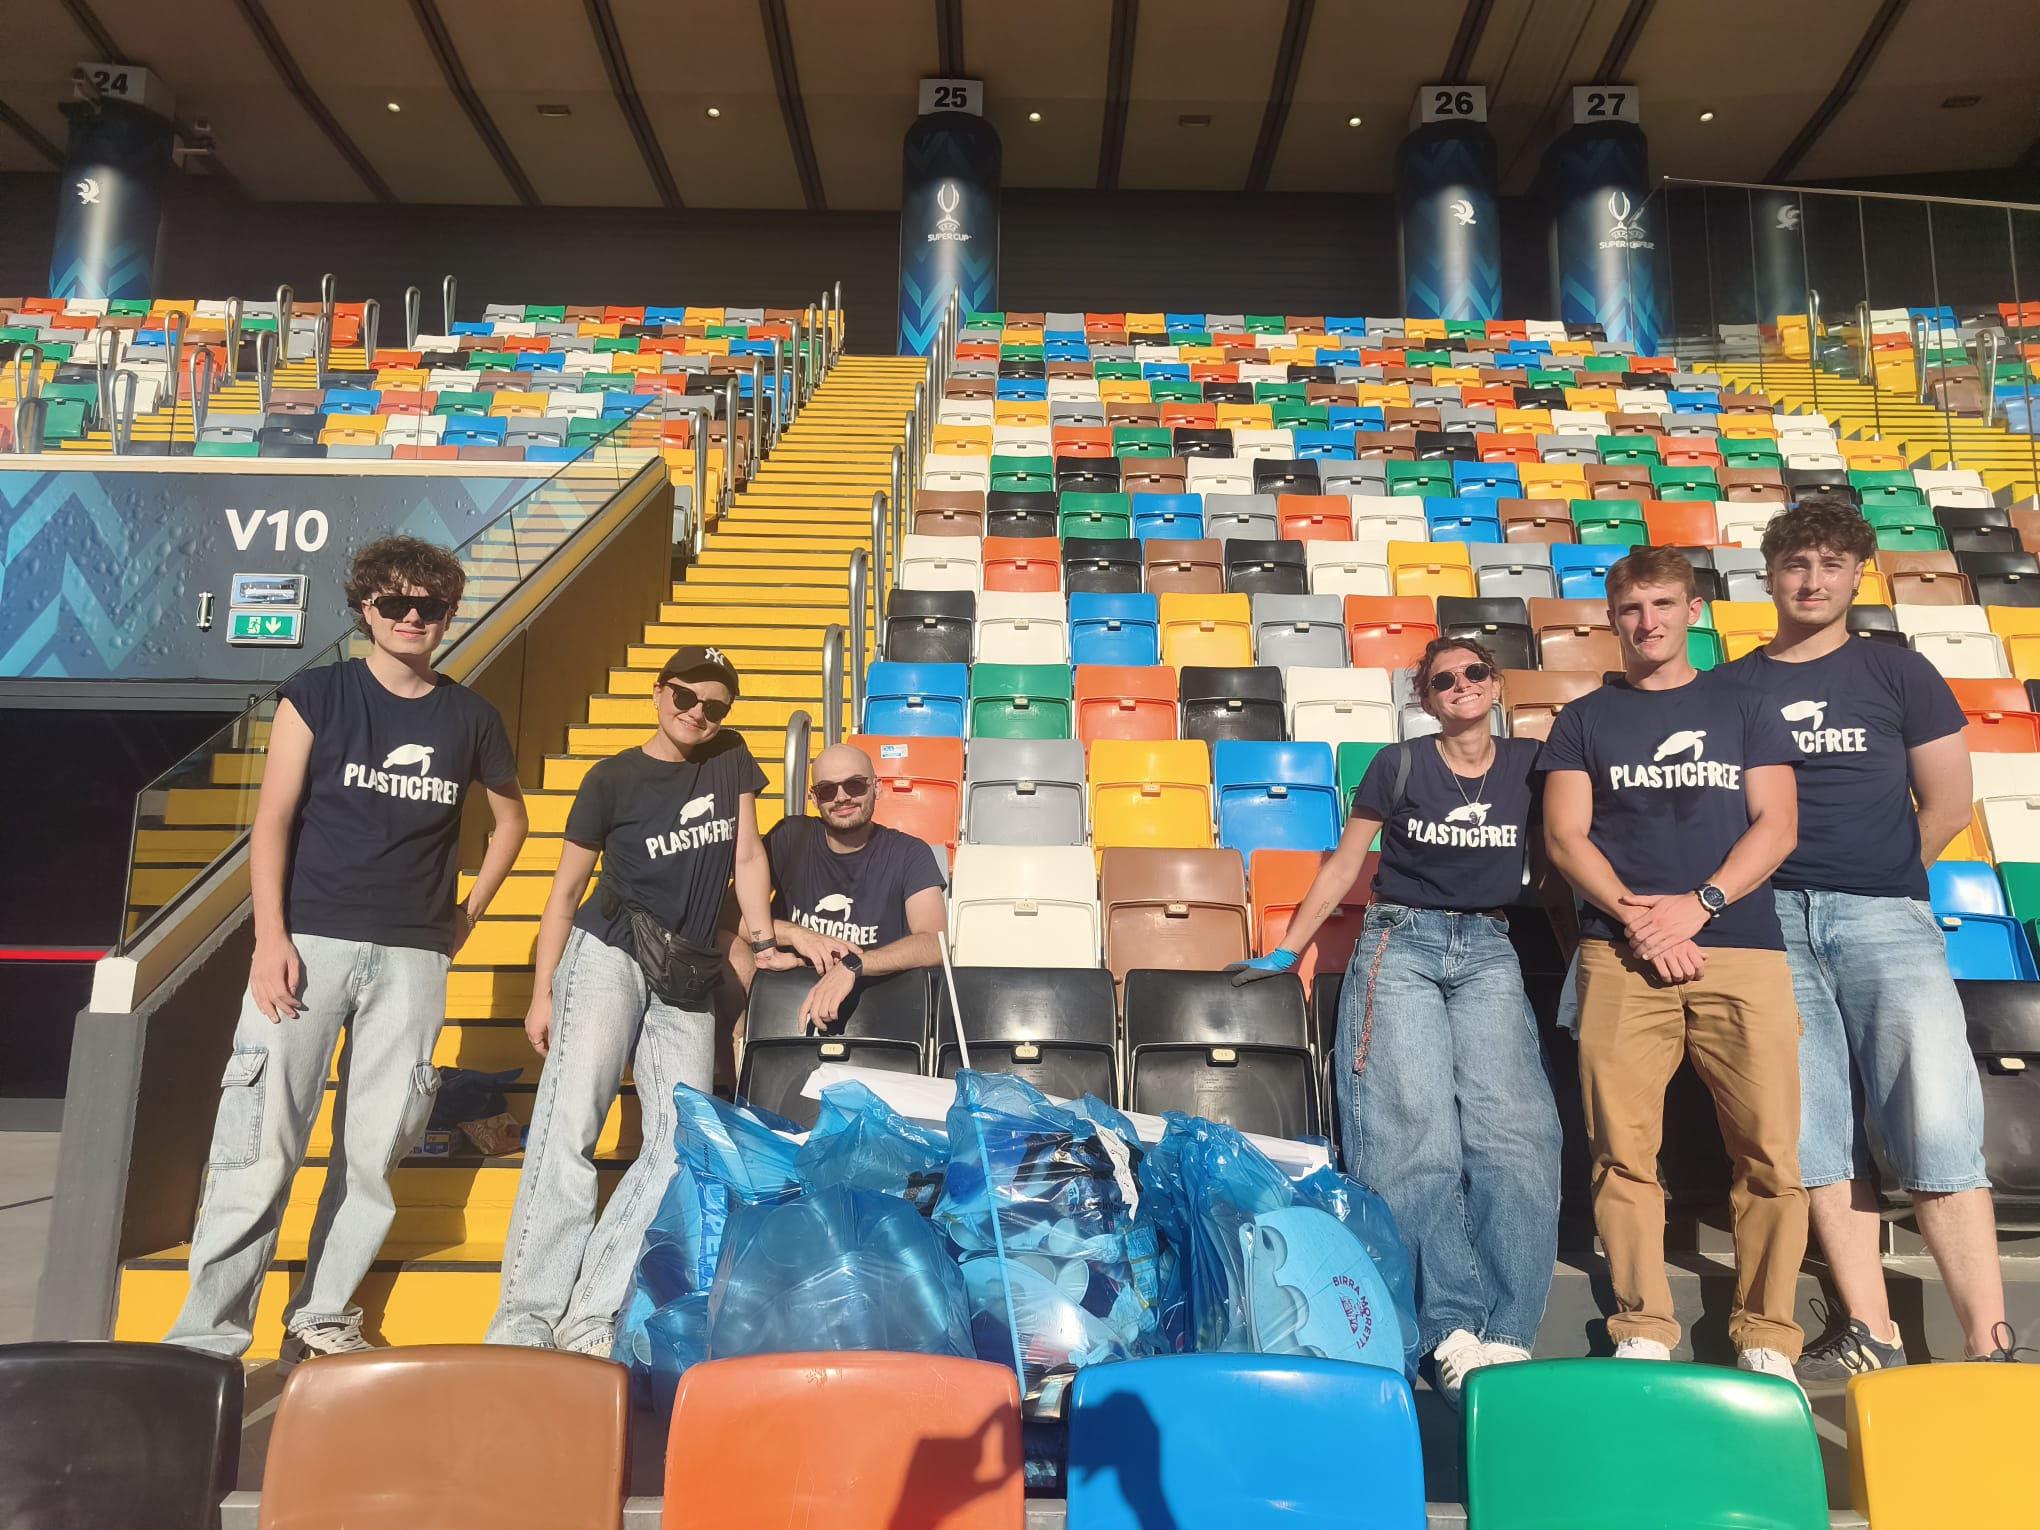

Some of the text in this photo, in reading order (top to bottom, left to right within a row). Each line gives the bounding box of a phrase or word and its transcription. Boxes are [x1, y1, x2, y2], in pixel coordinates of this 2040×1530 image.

[94, 71, 128, 97] 24
[934, 86, 968, 109] 25
[1434, 91, 1474, 115] 26
[1587, 93, 1626, 116] 27
[225, 509, 329, 552] V10
[1609, 760, 1741, 790] PLASTICFREE
[1407, 818, 1518, 848] PLASTICFREE
[1332, 1275, 1360, 1296] BIRRA
